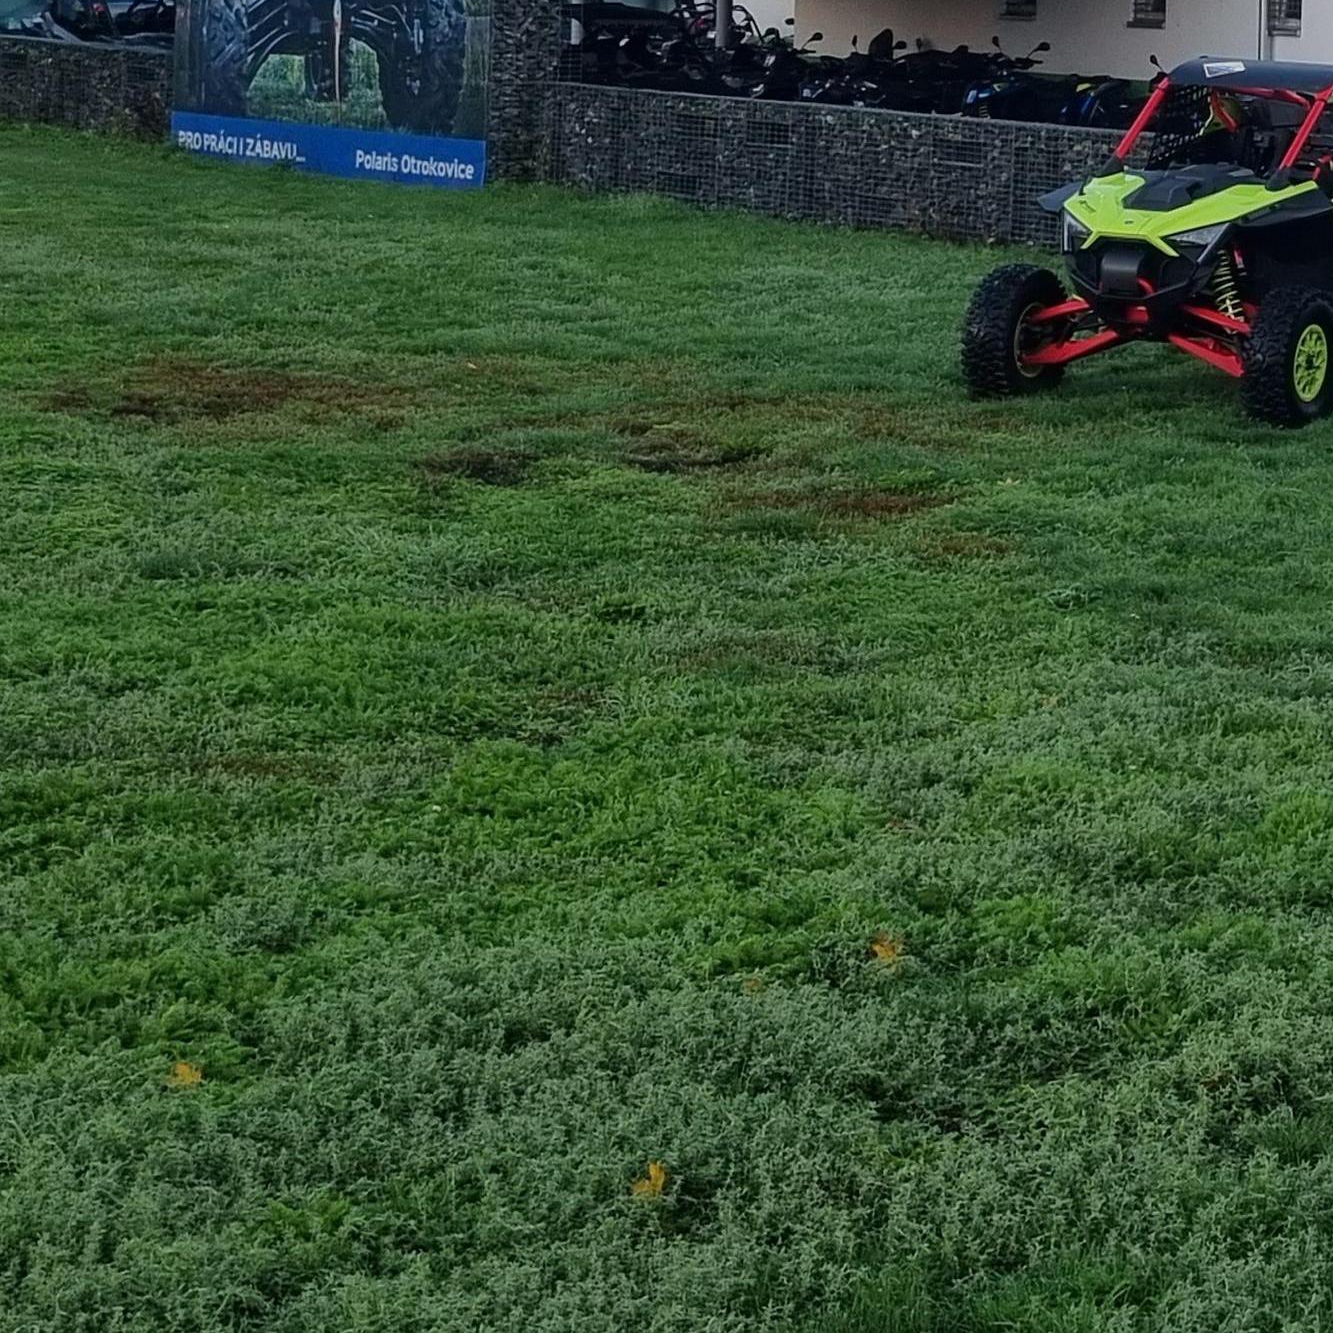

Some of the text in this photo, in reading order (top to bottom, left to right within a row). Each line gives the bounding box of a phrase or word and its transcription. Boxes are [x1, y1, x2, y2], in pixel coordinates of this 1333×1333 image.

[178, 130, 202, 150] PRO
[203, 130, 237, 154] PRÁCI
[356, 149, 474, 180] Polaris Otrokovice
